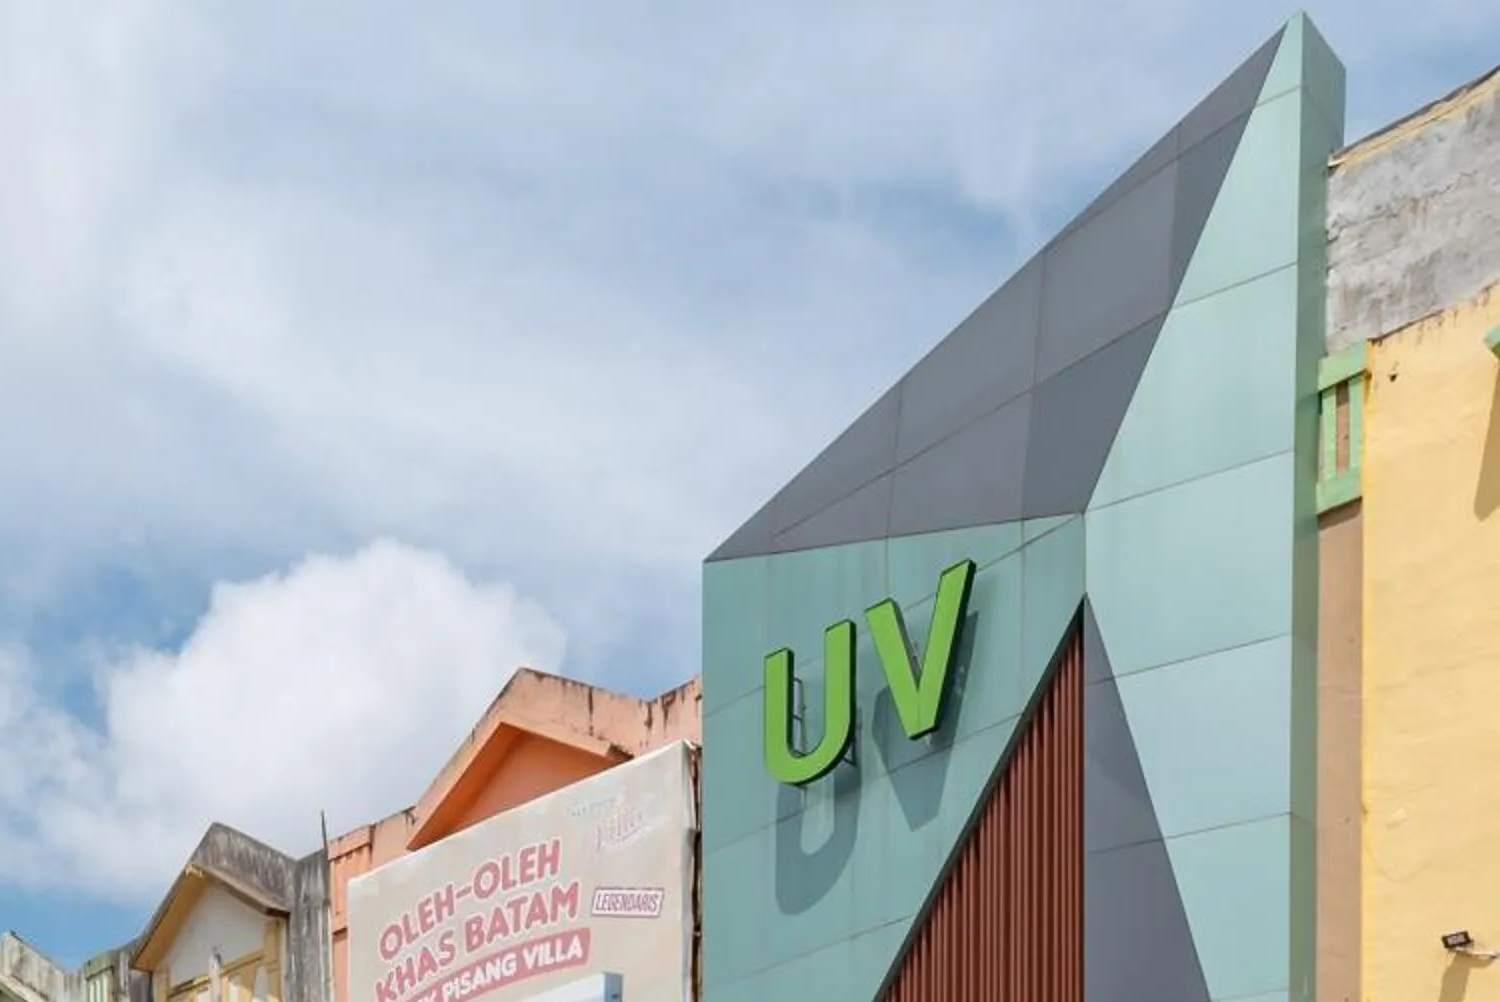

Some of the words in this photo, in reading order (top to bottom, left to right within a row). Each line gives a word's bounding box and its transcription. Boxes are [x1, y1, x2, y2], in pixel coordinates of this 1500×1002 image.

[764, 559, 976, 785] UV
[379, 839, 561, 961] OLEH-OLEH
[464, 881, 579, 953] BATAM
[522, 936, 583, 969] VILLA
